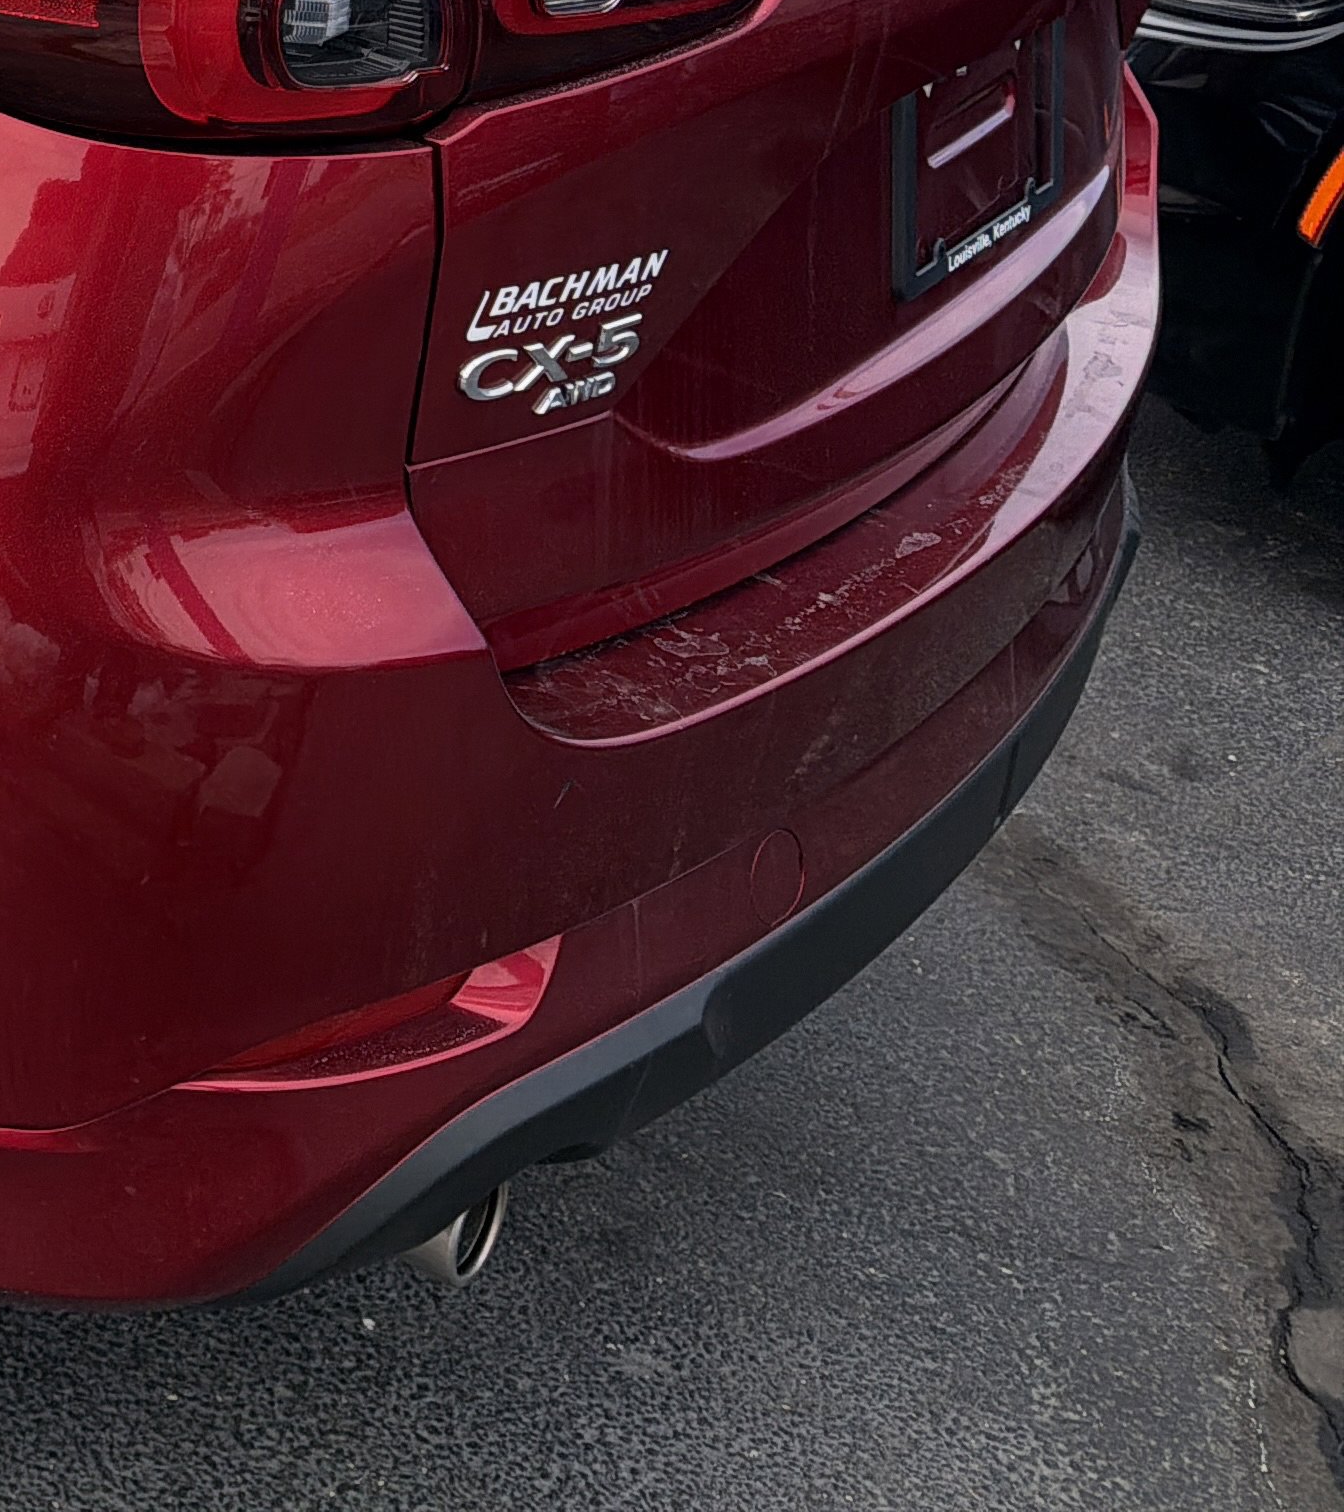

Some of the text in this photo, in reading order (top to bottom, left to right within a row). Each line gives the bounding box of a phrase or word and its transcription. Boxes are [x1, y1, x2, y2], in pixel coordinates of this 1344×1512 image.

[948, 205, 1031, 272] Louisville, Kentucky
[489, 249, 669, 317] BACHMAN
[493, 284, 653, 338] AUTO GROUP
[457, 313, 643, 401] CX-5
[531, 371, 616, 415] AWD
